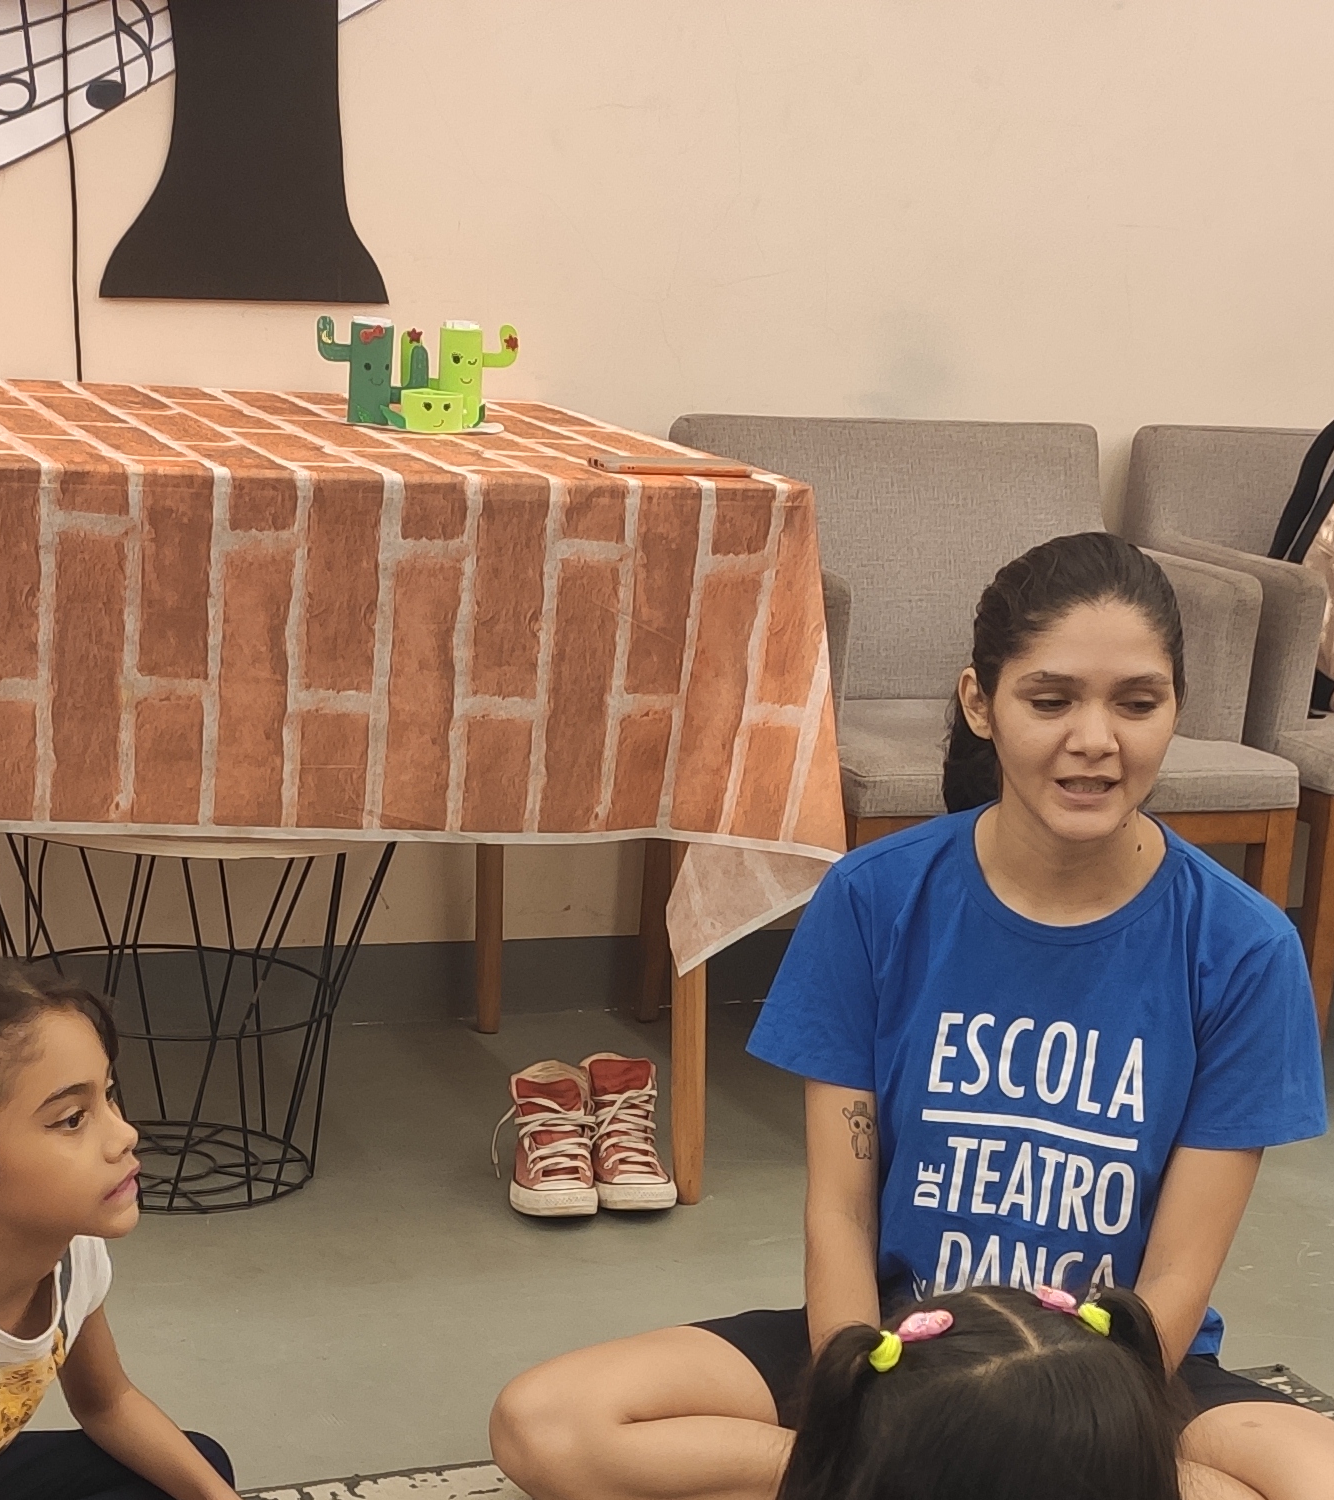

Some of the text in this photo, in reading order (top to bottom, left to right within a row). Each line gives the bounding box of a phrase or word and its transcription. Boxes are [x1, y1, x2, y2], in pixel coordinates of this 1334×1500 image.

[928, 1012, 1144, 1122] ESCOLA
[913, 1136, 1135, 1235] DE TEATRO
